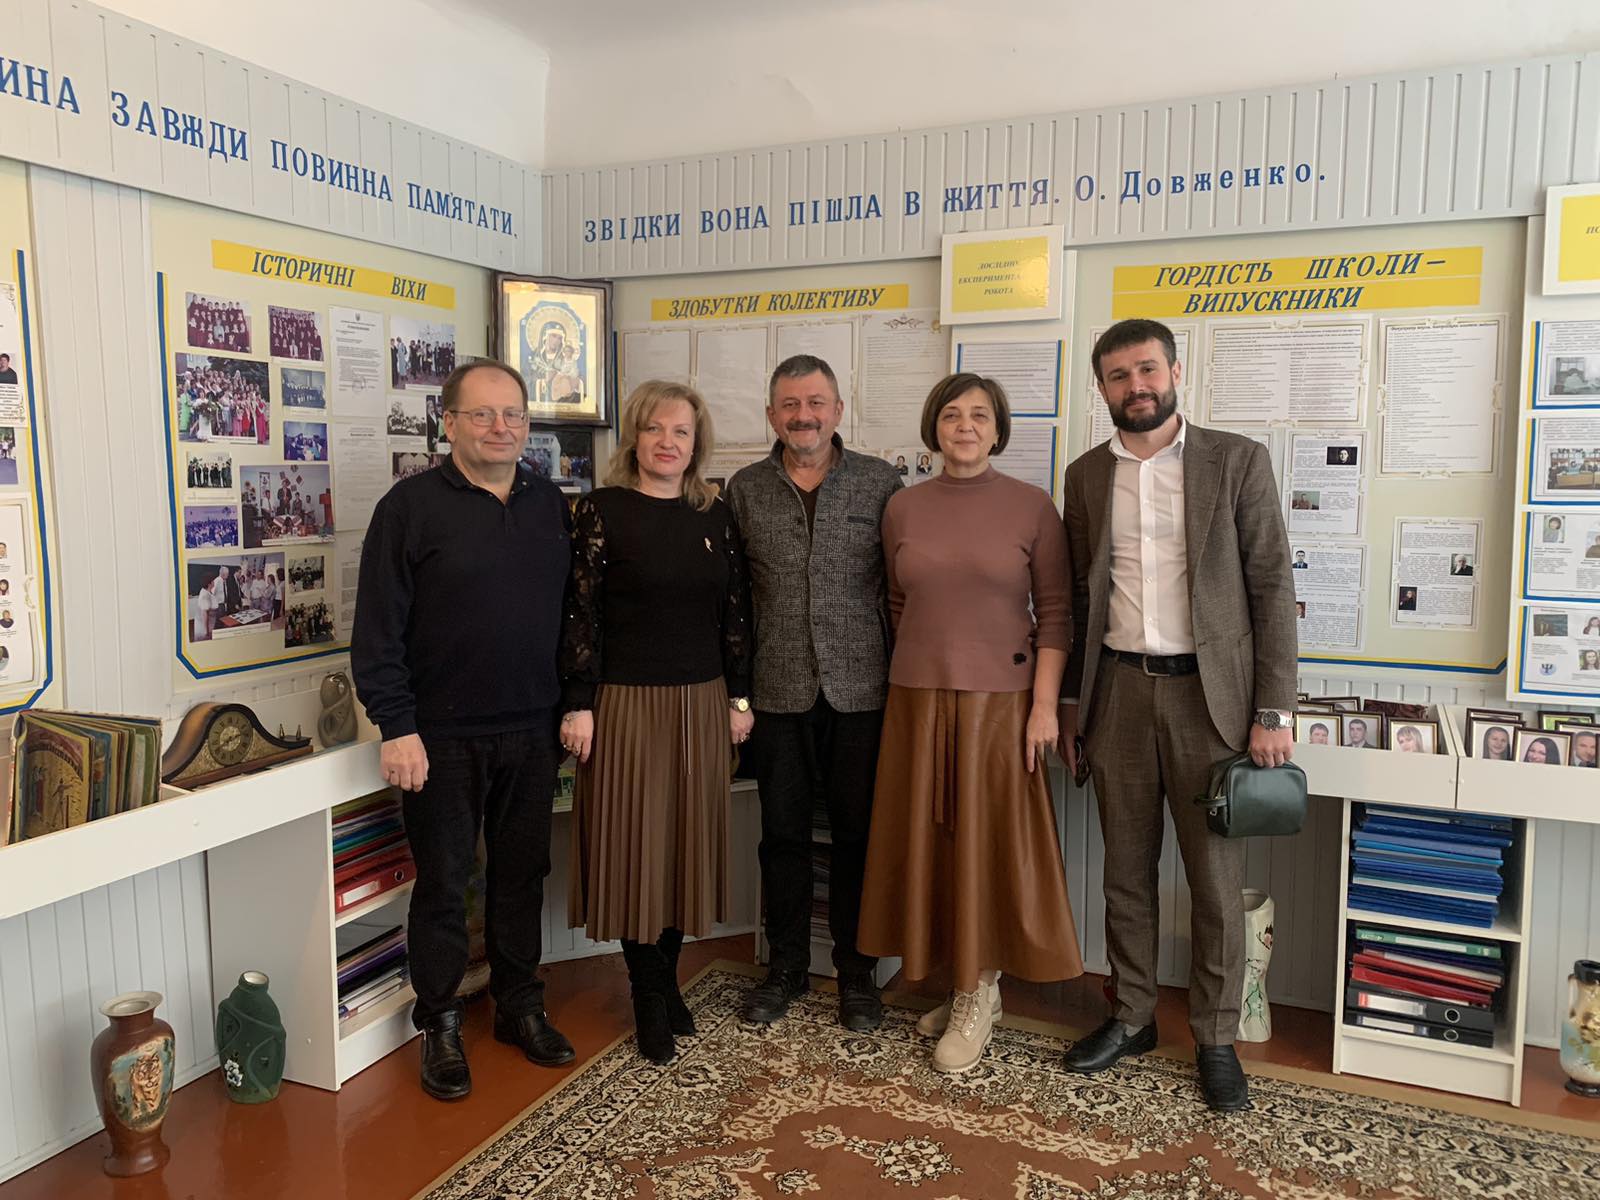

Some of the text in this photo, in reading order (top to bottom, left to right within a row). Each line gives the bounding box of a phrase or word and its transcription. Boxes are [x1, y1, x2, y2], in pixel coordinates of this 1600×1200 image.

[111, 90, 249, 164] ЗАВЖДИ
[270, 139, 393, 202] ПОВИННА
[584, 163, 1326, 245] ЗВІДКИ ВОНА ПІШЛА В ЖИТТЯ. О. Довженко.
[251, 251, 428, 301] ІСТОРИЧНІ ВІХИ
[1154, 261, 1274, 288] ГОРДІСТЬ
[668, 288, 885, 319] ЗДОБУТКИ КОЛЕКТИВУ
[1183, 286, 1365, 314] ВИПУСКНИКИ
